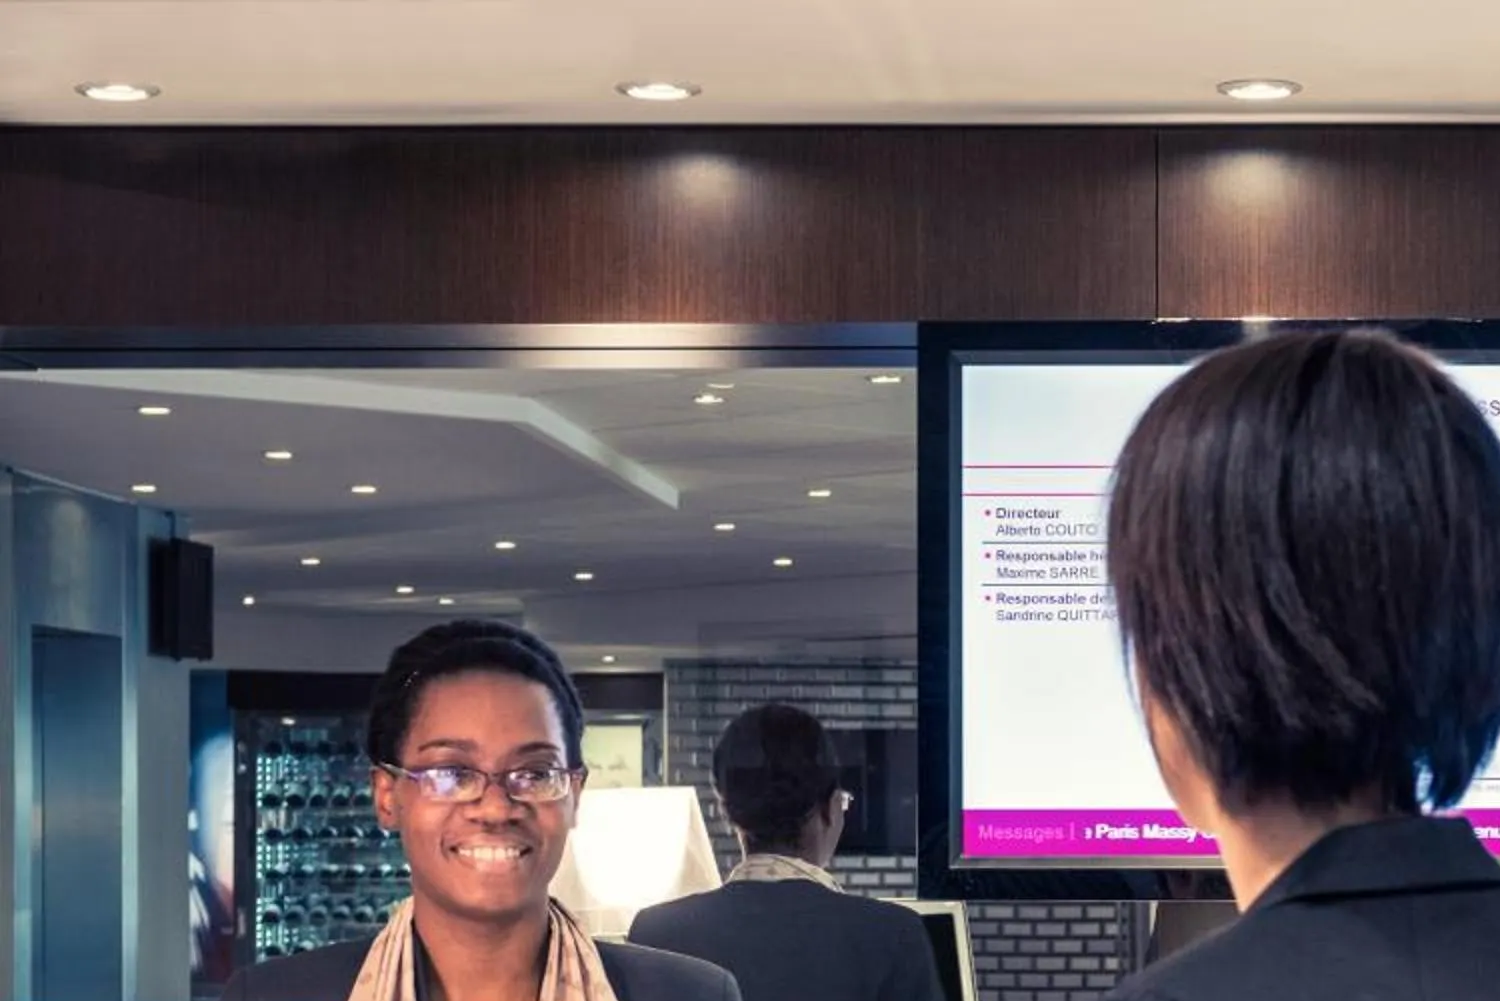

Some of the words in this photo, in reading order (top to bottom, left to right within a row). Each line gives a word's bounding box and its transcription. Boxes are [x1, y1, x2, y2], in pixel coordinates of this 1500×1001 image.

[995, 507, 1061, 519] Directeur
[995, 523, 1041, 536] Alberto
[995, 550, 1087, 563] Responsable
[996, 567, 1047, 579] Maxime
[995, 593, 1087, 605] Responsable
[996, 609, 1054, 621] Sandrine
[978, 825, 1064, 843] Messages
[1095, 824, 1140, 839] Paris
[1142, 824, 1198, 843] Massy
